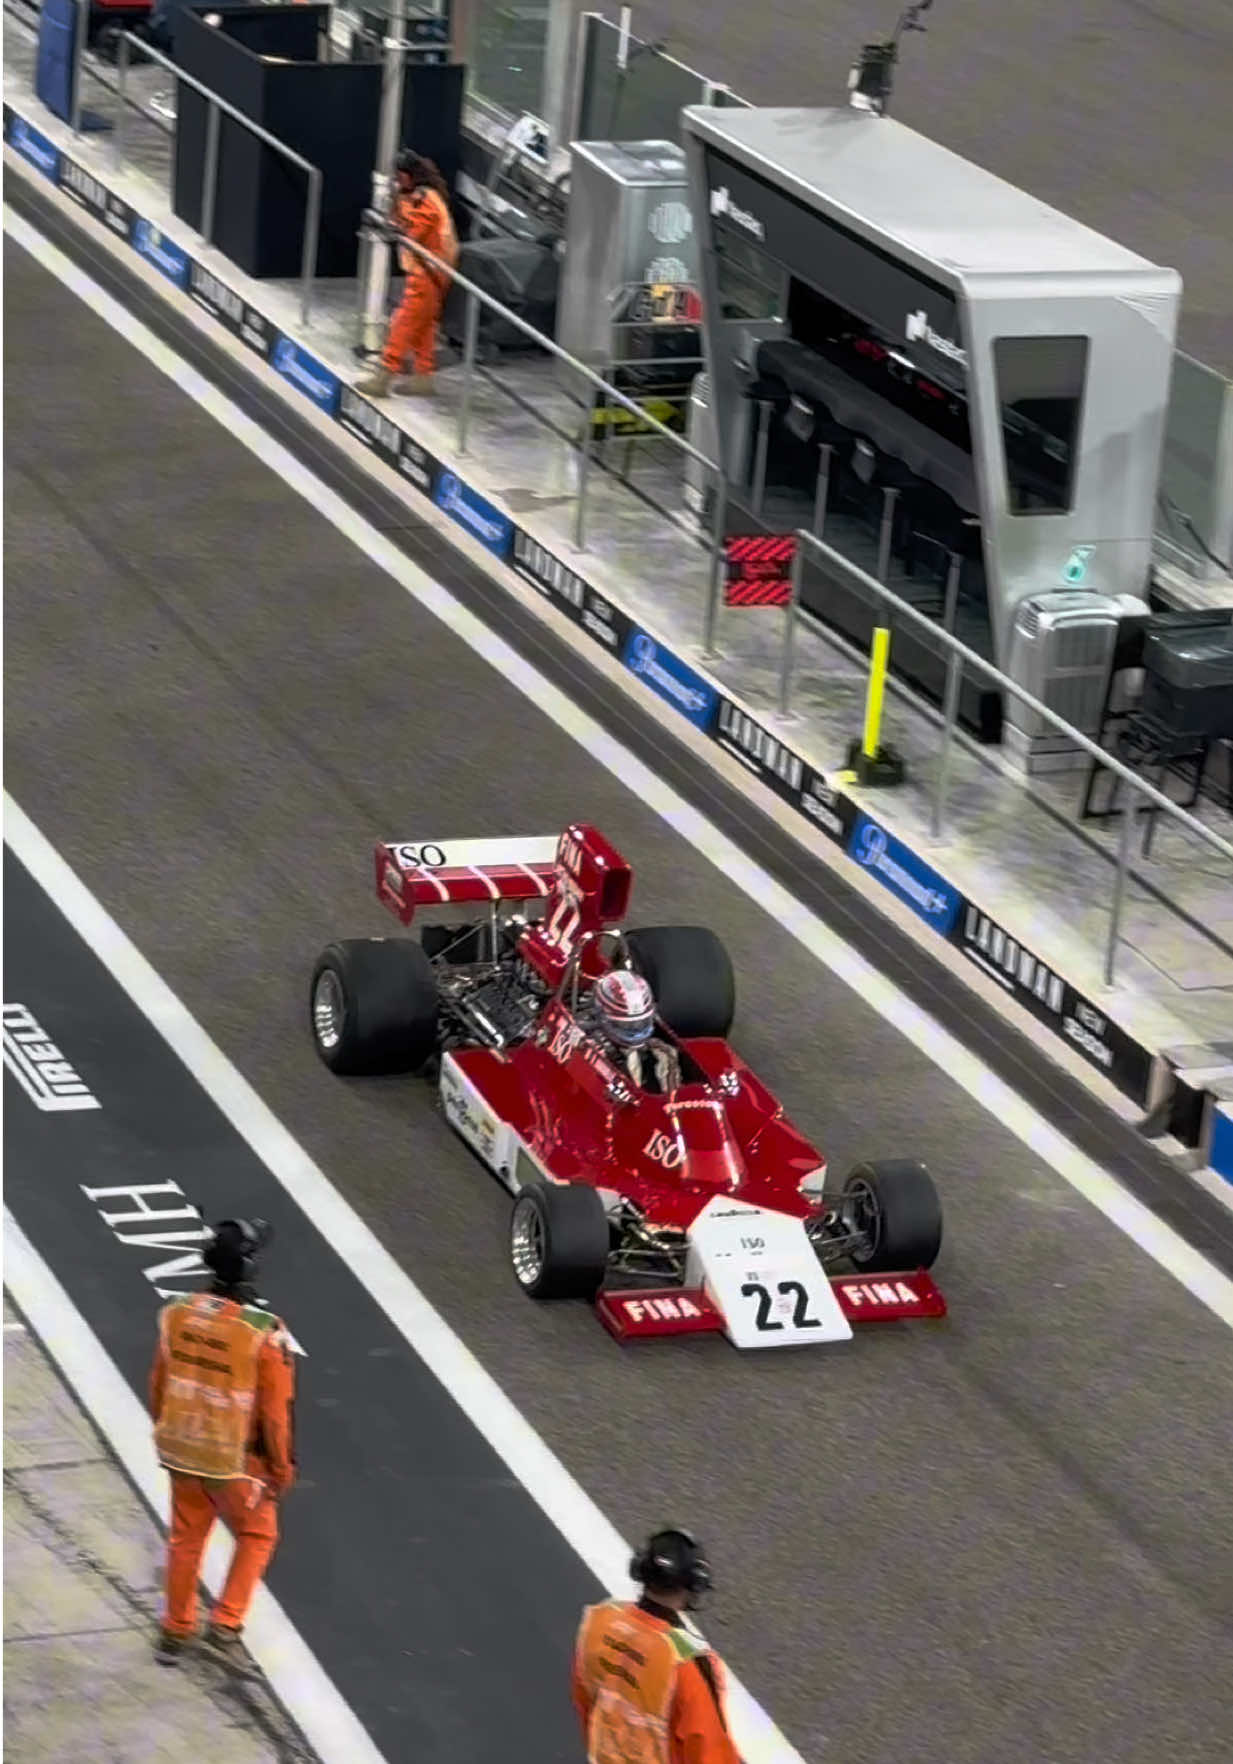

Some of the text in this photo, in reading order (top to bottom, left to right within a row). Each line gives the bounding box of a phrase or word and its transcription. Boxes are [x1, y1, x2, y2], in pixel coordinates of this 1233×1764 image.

[388, 844, 446, 867] SO
[641, 1127, 684, 1169] ISO
[740, 1281, 823, 1329] 22
[842, 1282, 919, 1307] FINA
[622, 1298, 702, 1323] FINA
